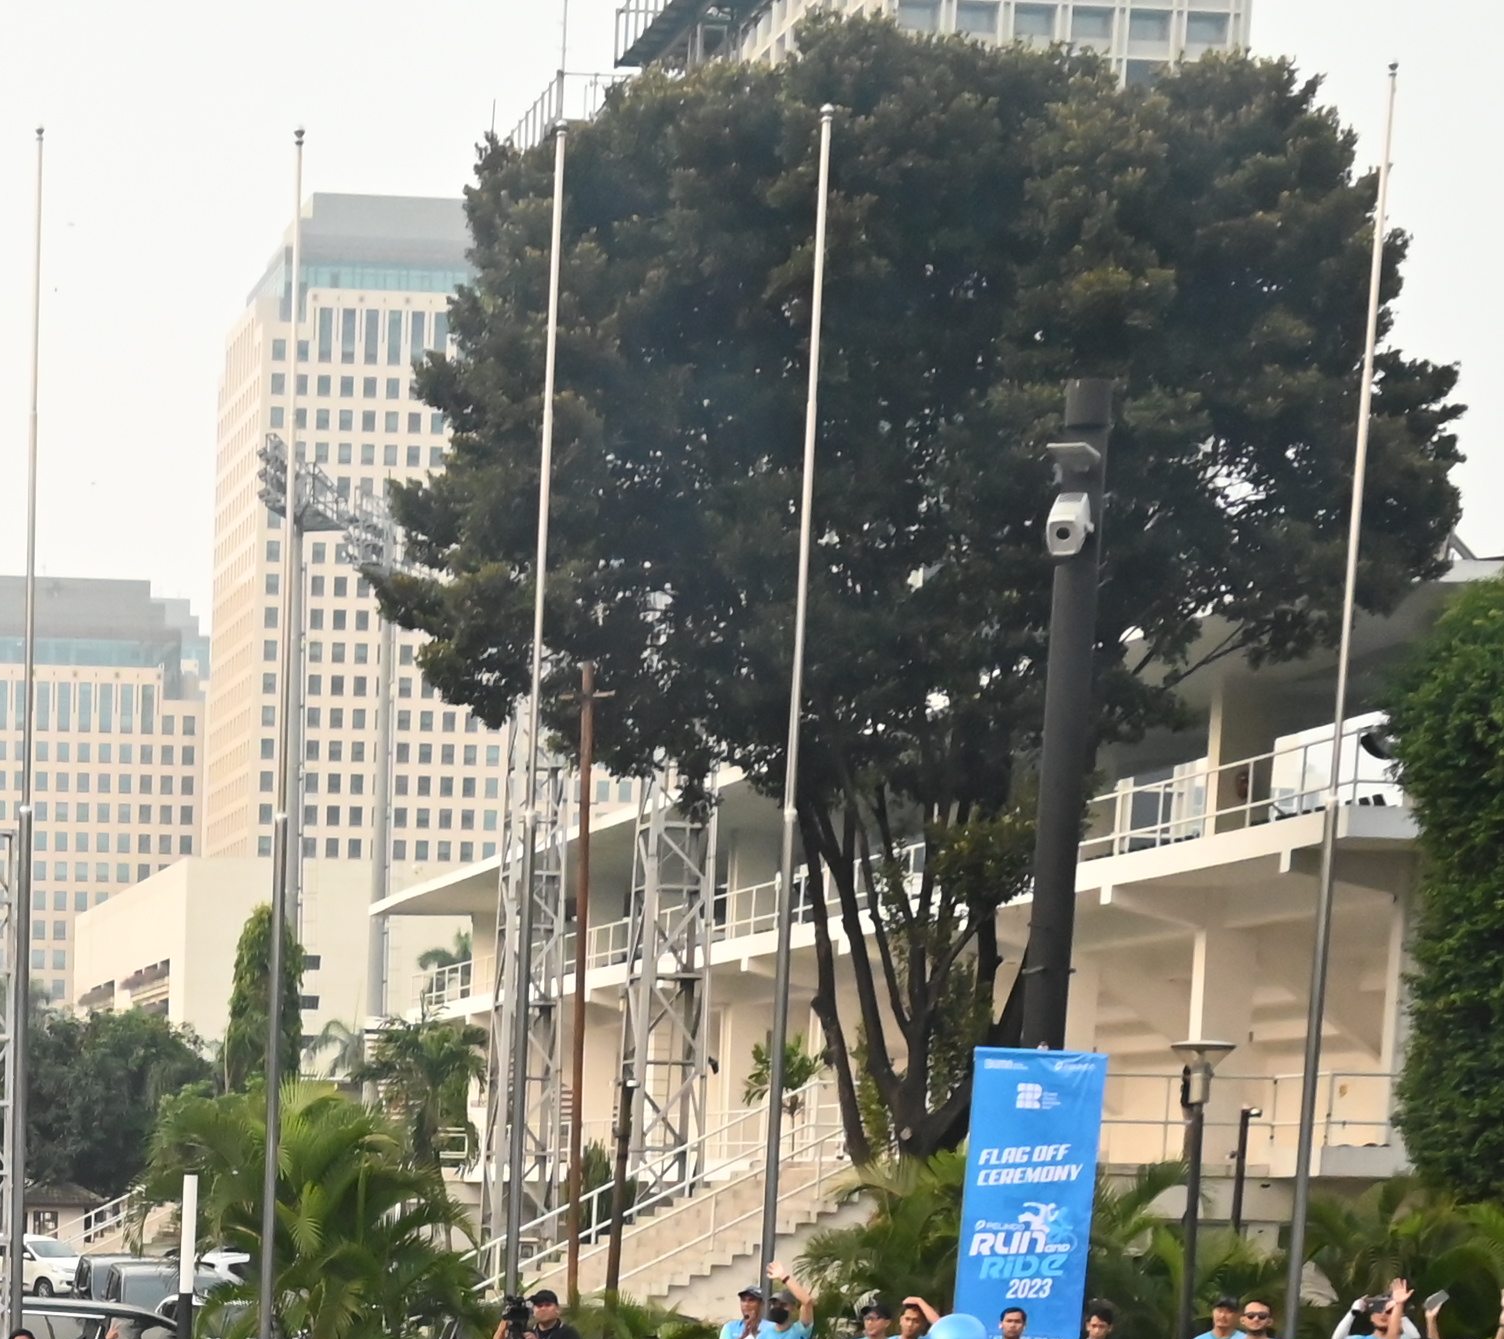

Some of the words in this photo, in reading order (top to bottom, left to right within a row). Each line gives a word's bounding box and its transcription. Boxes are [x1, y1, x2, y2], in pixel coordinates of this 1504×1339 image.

[978, 1146, 1031, 1165] FLAG
[1032, 1144, 1072, 1162] OFF
[977, 1163, 1083, 1186] CEREMONY
[1005, 1278, 1053, 1299] 2023
